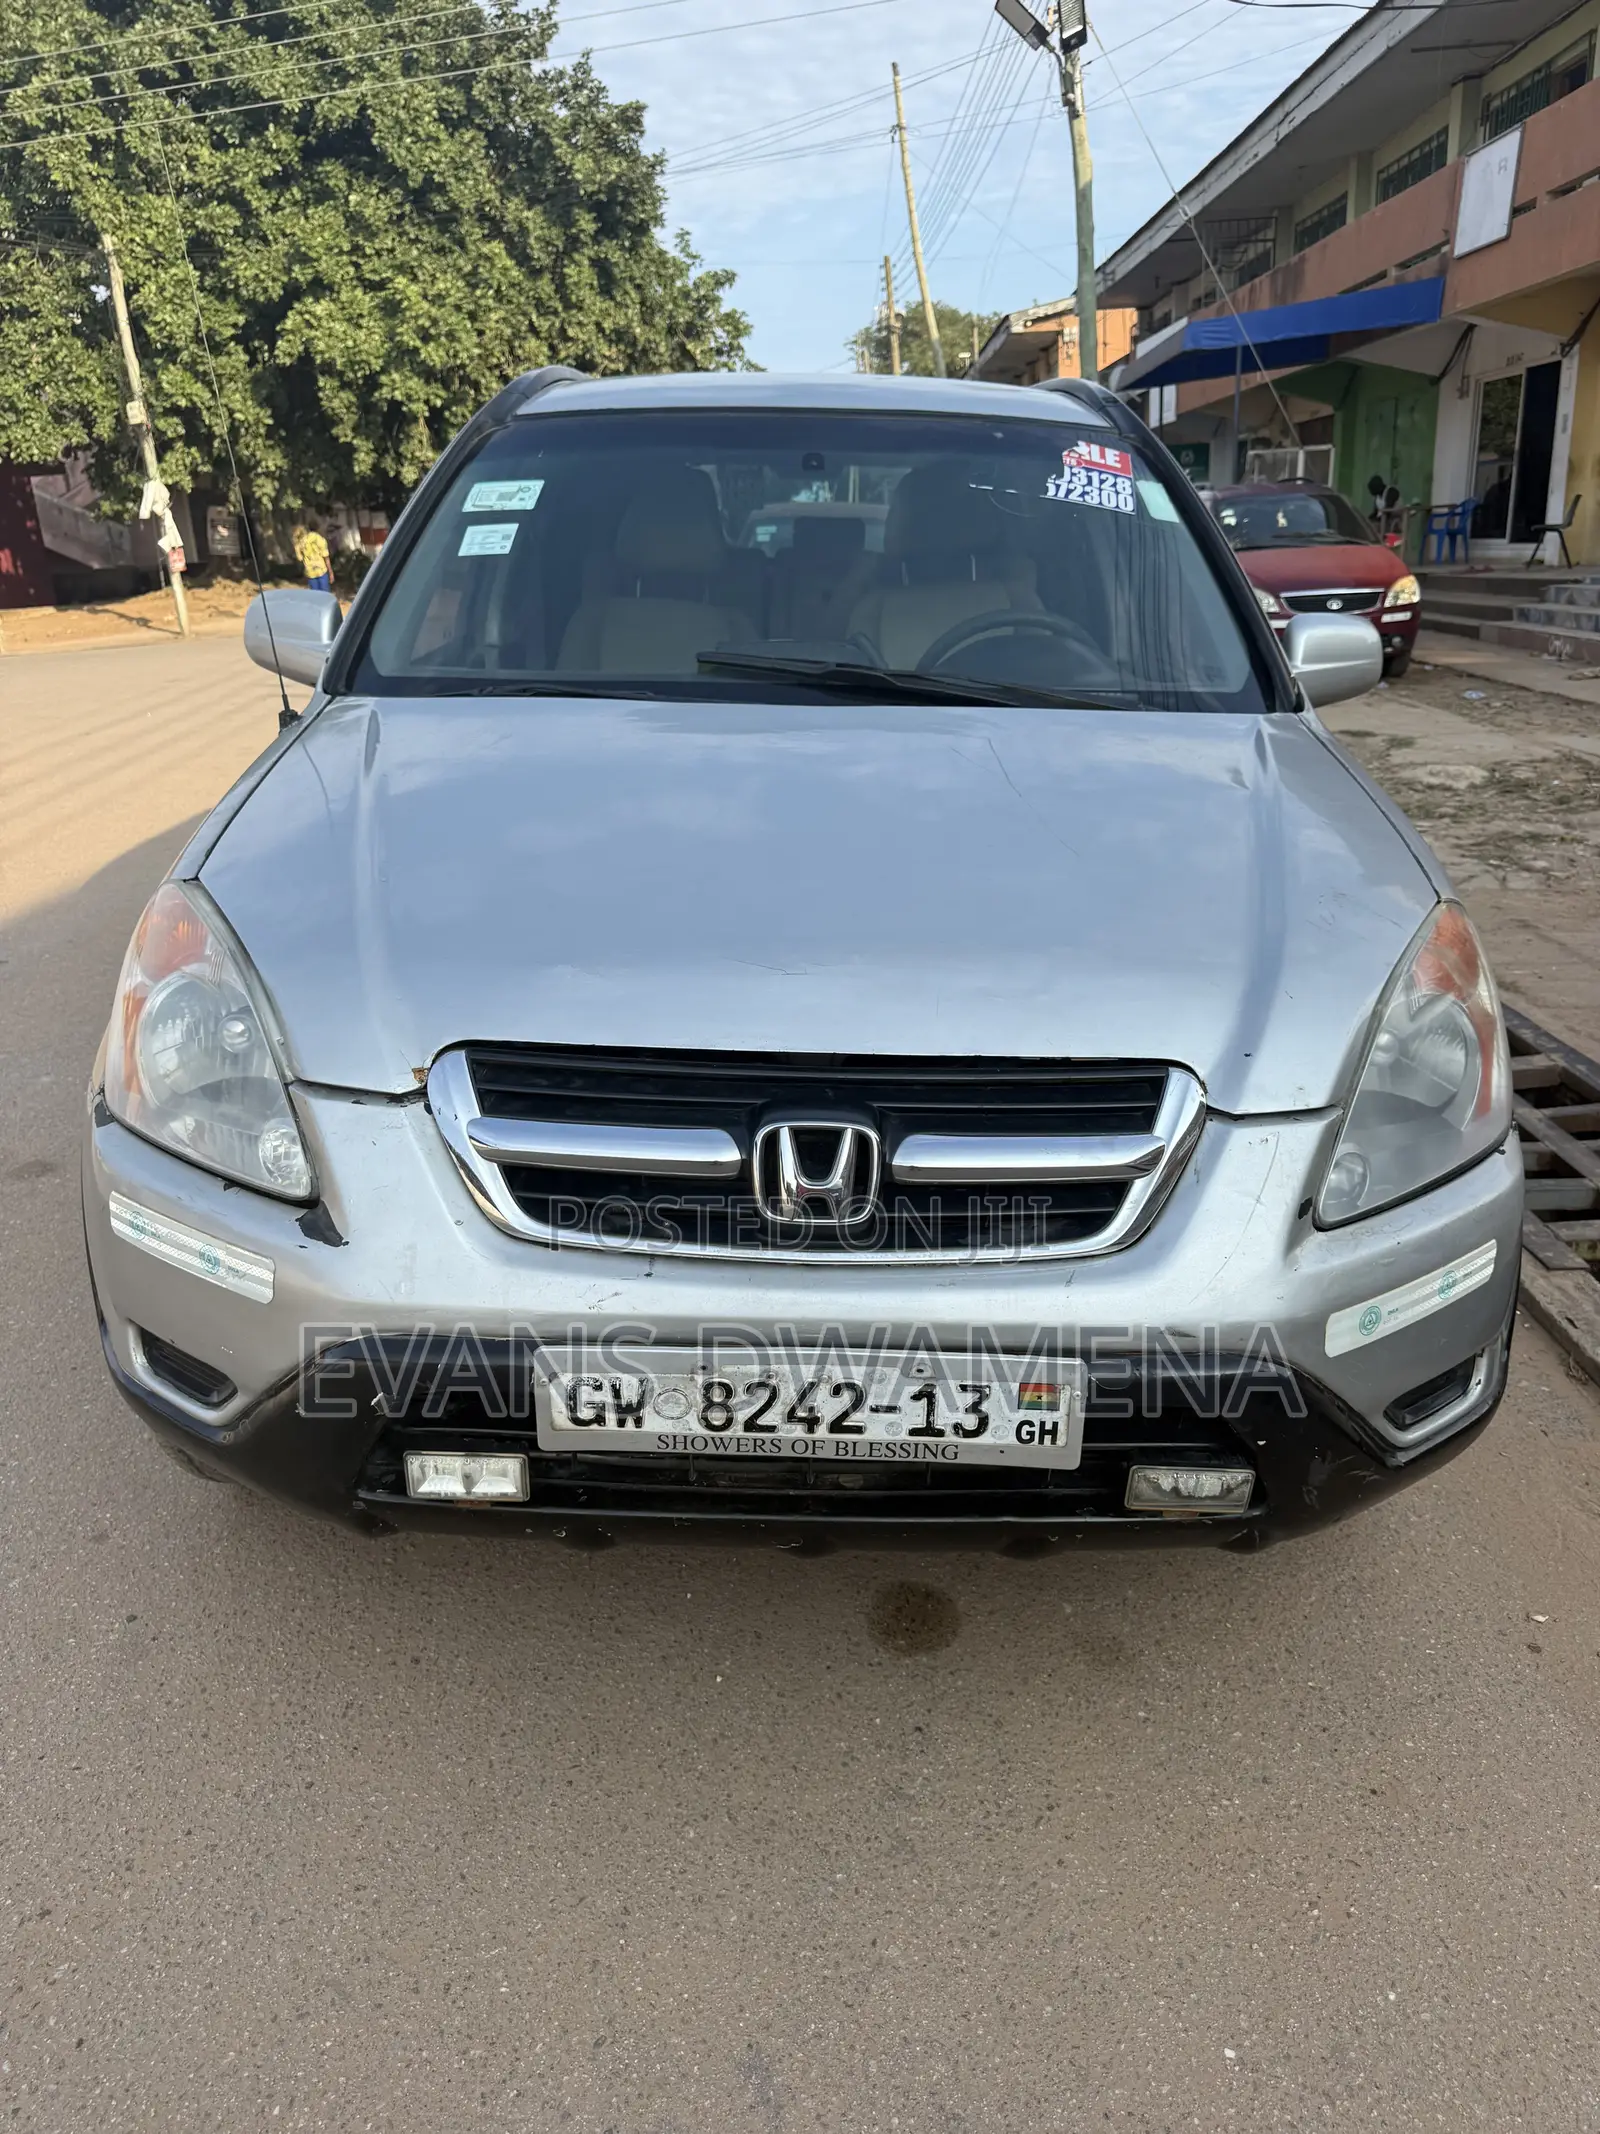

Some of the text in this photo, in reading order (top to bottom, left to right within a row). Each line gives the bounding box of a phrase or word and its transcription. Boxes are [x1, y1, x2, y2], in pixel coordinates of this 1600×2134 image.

[567, 1376, 992, 1439] GW 8242-13
[1014, 1419, 1059, 1446] GH
[656, 1433, 960, 1461] SHOWERS OF BLESSING
